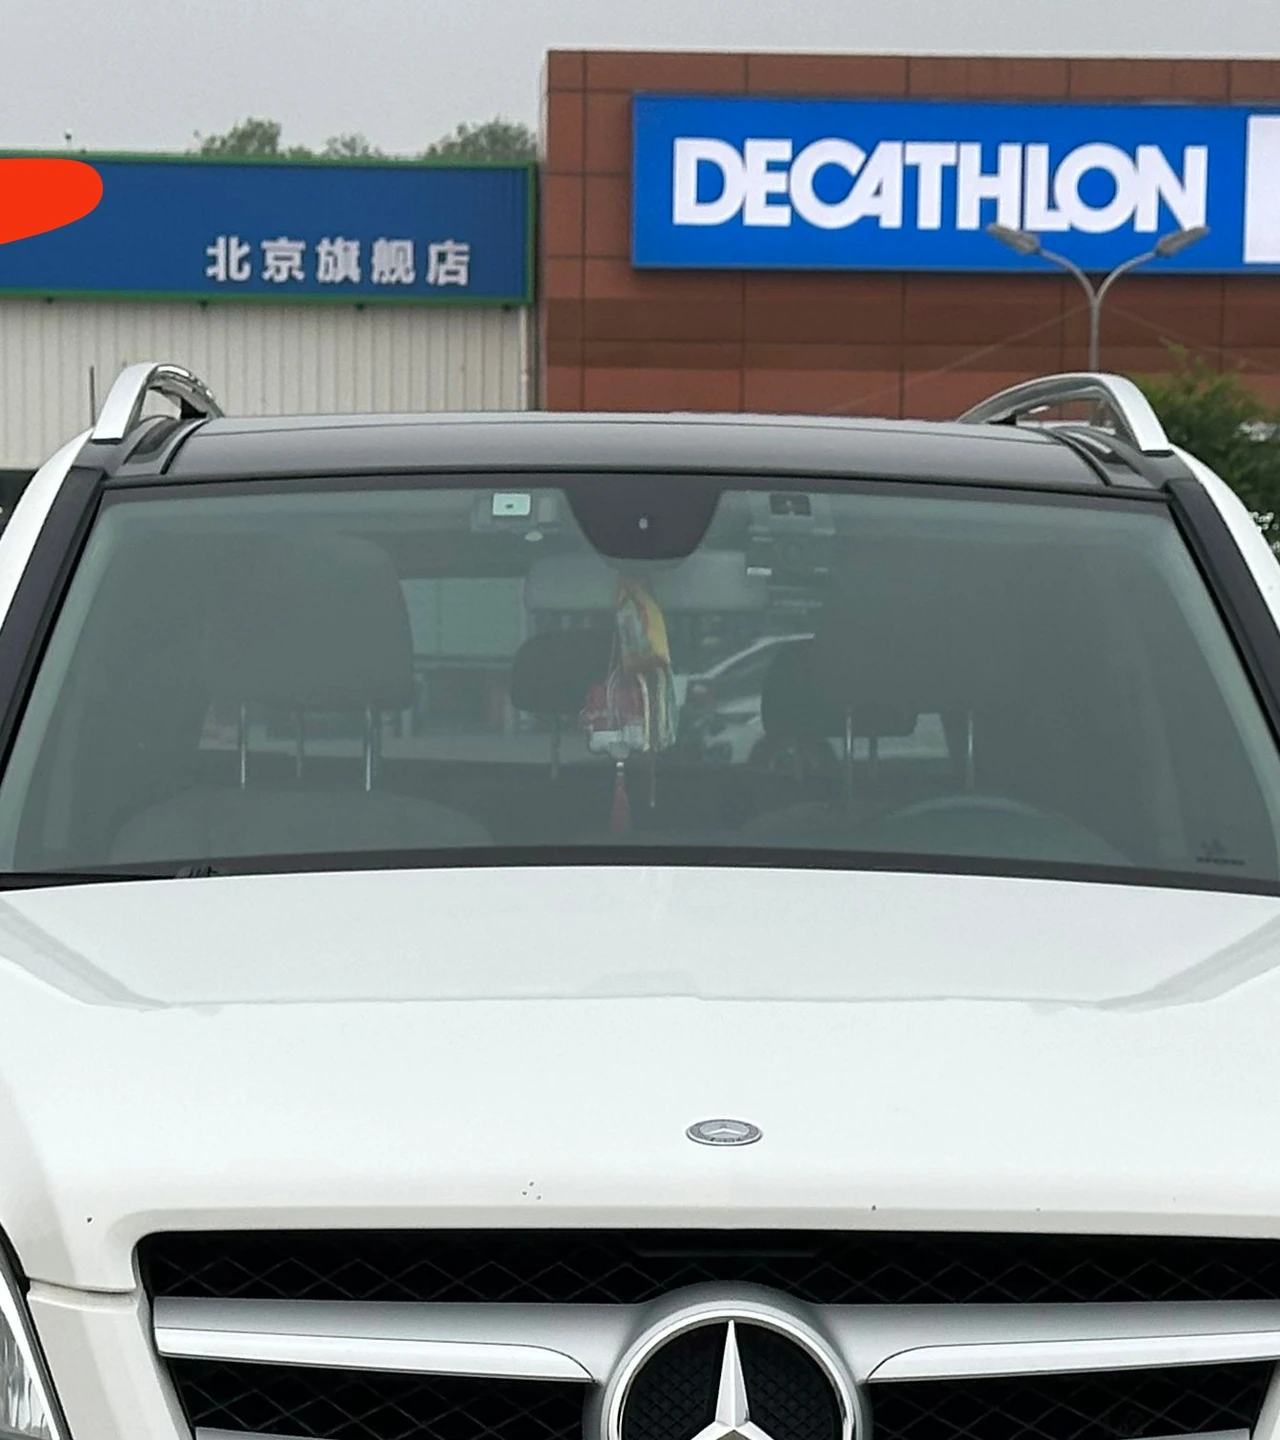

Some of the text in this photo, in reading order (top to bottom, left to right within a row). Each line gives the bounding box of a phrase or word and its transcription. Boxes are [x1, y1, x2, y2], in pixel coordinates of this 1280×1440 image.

[671, 137, 1208, 234] DECATHLON
[205, 235, 471, 286] 北京旗舰店
